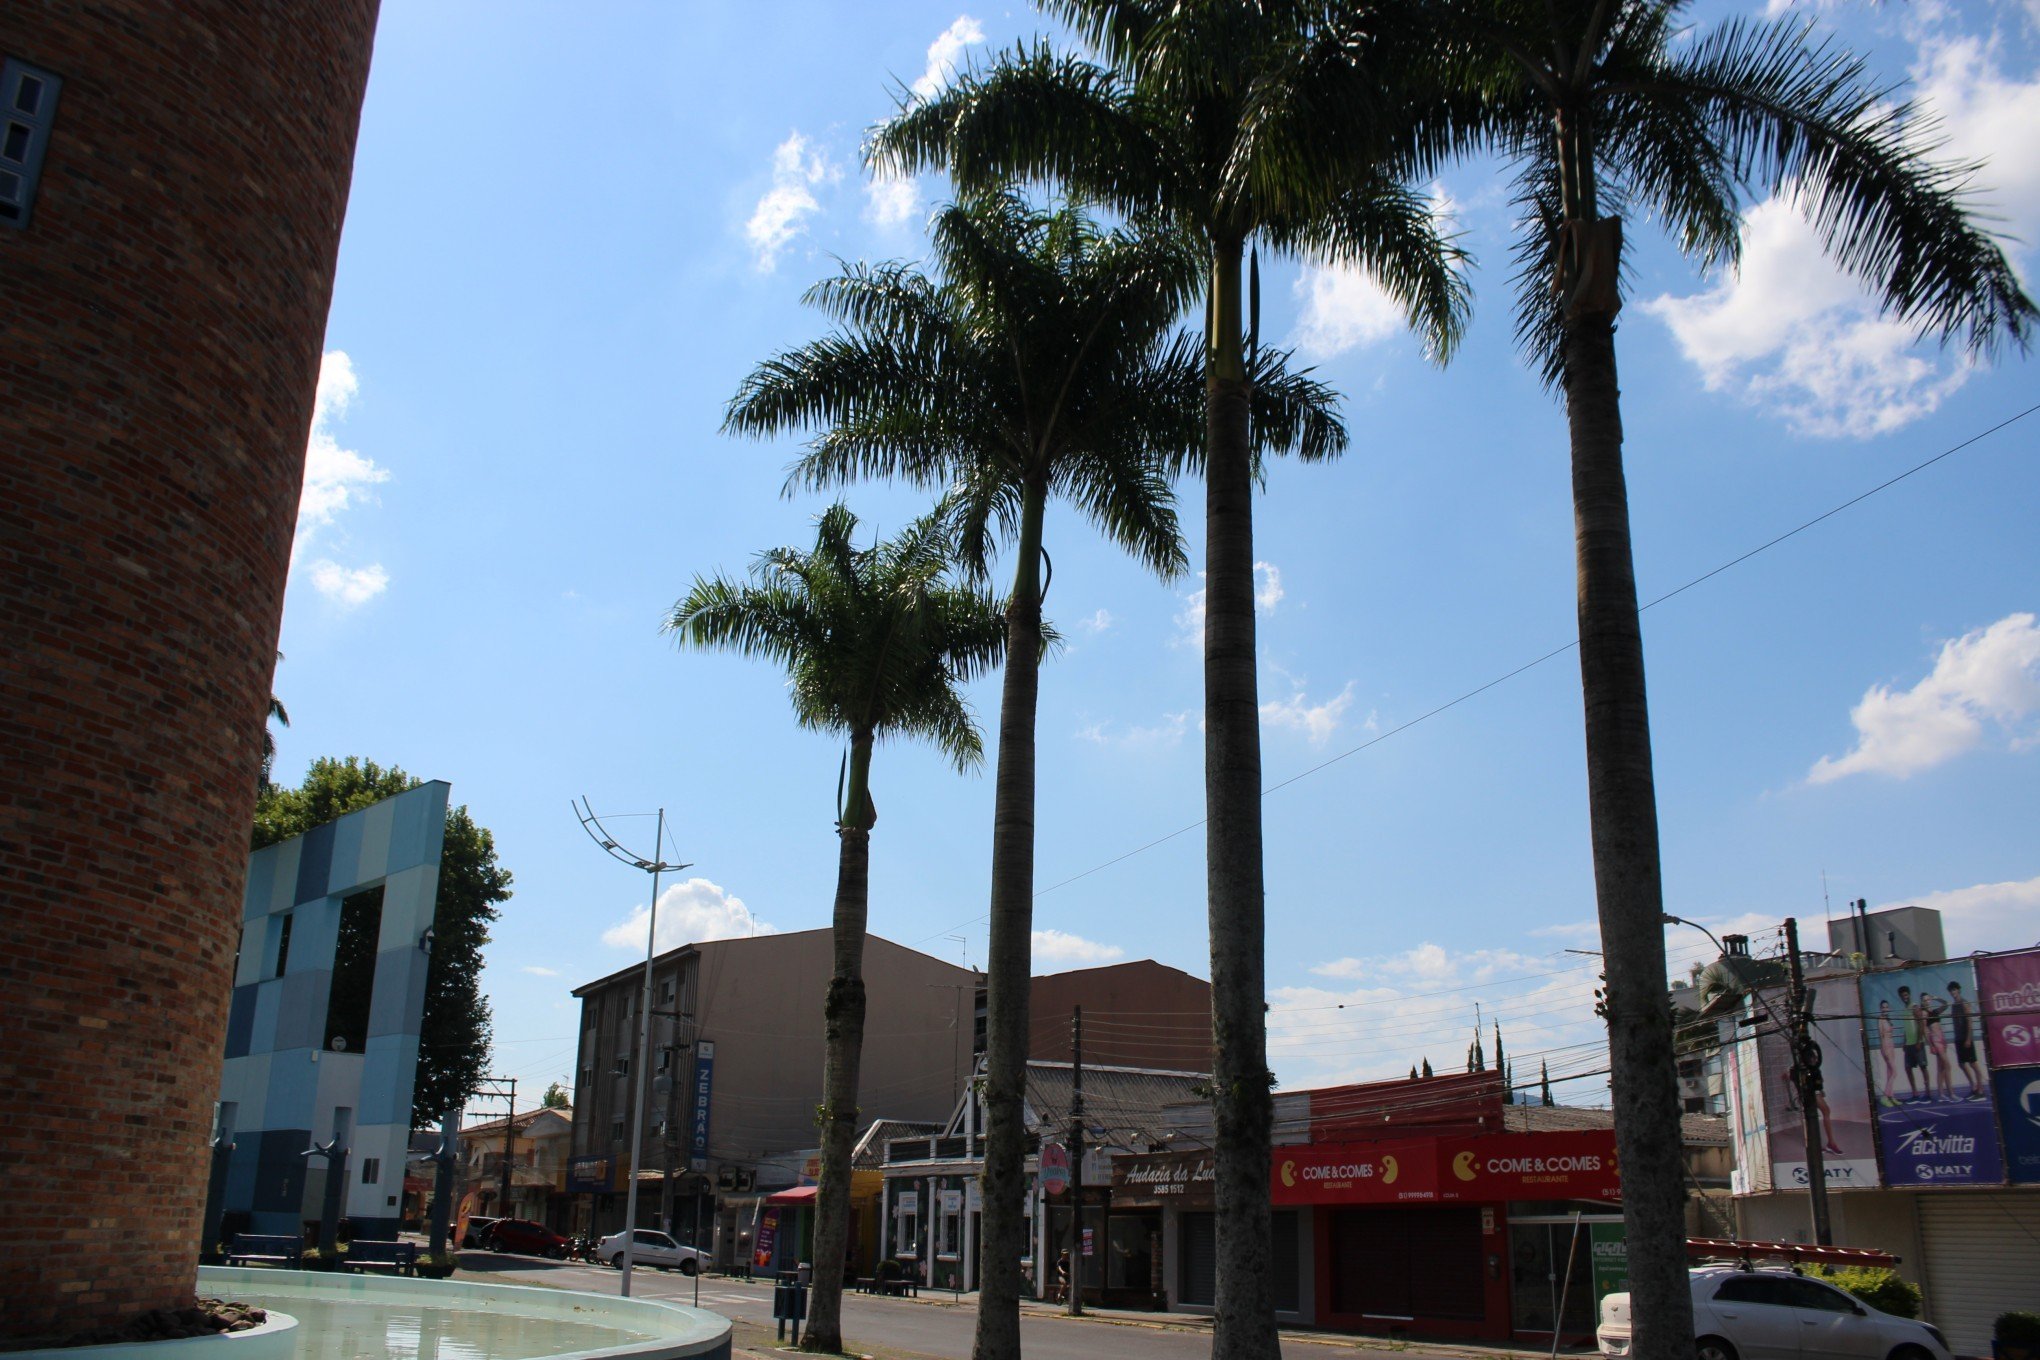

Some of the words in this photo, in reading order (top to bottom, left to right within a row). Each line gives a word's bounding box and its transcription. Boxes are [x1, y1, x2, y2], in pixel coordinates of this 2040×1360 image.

[1302, 1166, 1331, 1180] COME
[1331, 1165, 1339, 1178] &
[1339, 1163, 1373, 1179] COMES
[1487, 1158, 1532, 1173] COME
[1534, 1158, 1545, 1172] &
[1546, 1156, 1601, 1172] COMES
[1934, 1165, 1973, 1175] KATY
[1173, 1163, 1188, 1182] da
[1522, 1175, 1569, 1184] RESTAURANTE
[1825, 1167, 1853, 1178] ATY
